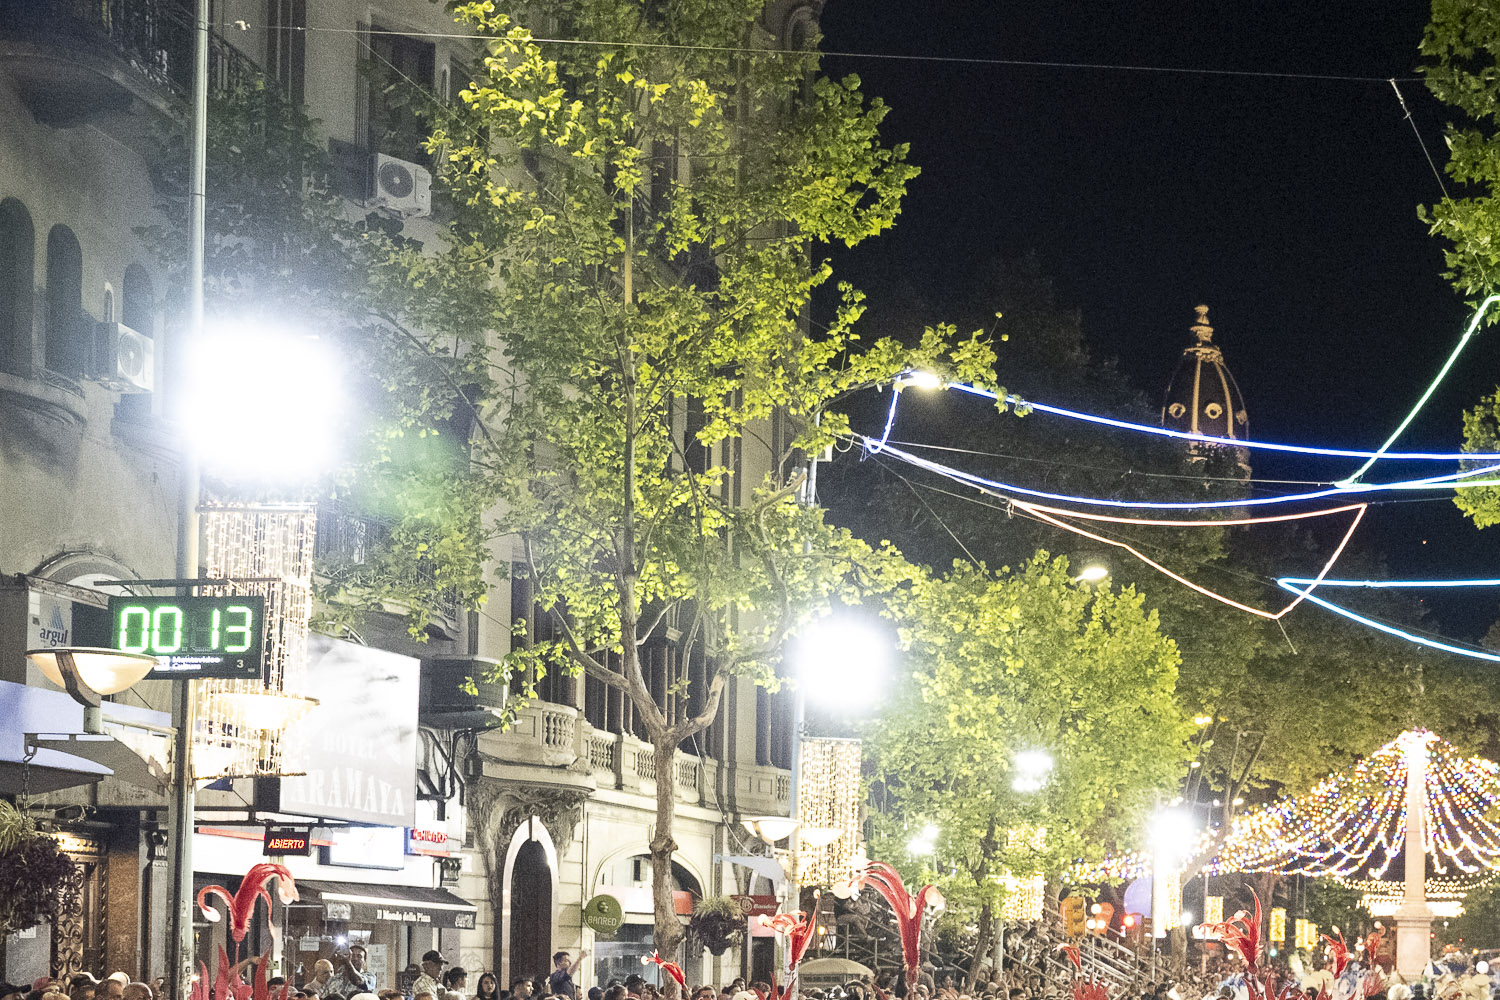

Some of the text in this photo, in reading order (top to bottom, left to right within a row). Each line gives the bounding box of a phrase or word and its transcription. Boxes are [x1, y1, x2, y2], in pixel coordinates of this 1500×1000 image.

[39, 628, 68, 647] argul
[236, 659, 244, 668] 3
[268, 838, 304, 850] ABIERTO
[587, 916, 617, 927] BANRED
